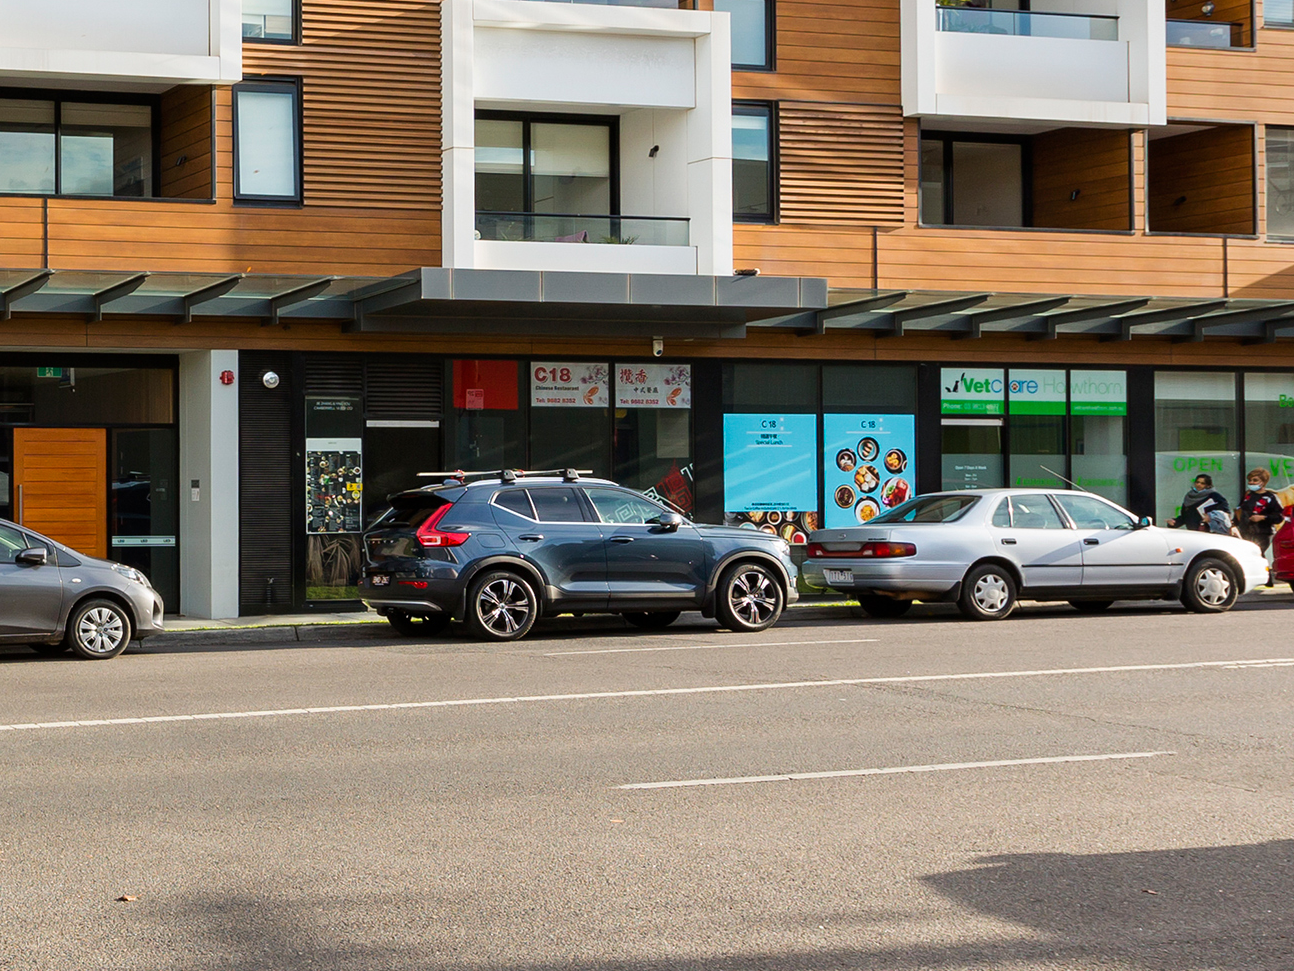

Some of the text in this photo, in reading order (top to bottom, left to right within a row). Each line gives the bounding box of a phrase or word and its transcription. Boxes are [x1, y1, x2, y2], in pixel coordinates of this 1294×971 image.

[534, 366, 572, 384] C18
[1043, 376, 1122, 395] Hawthorn
[1173, 457, 1223, 472] OPEN
